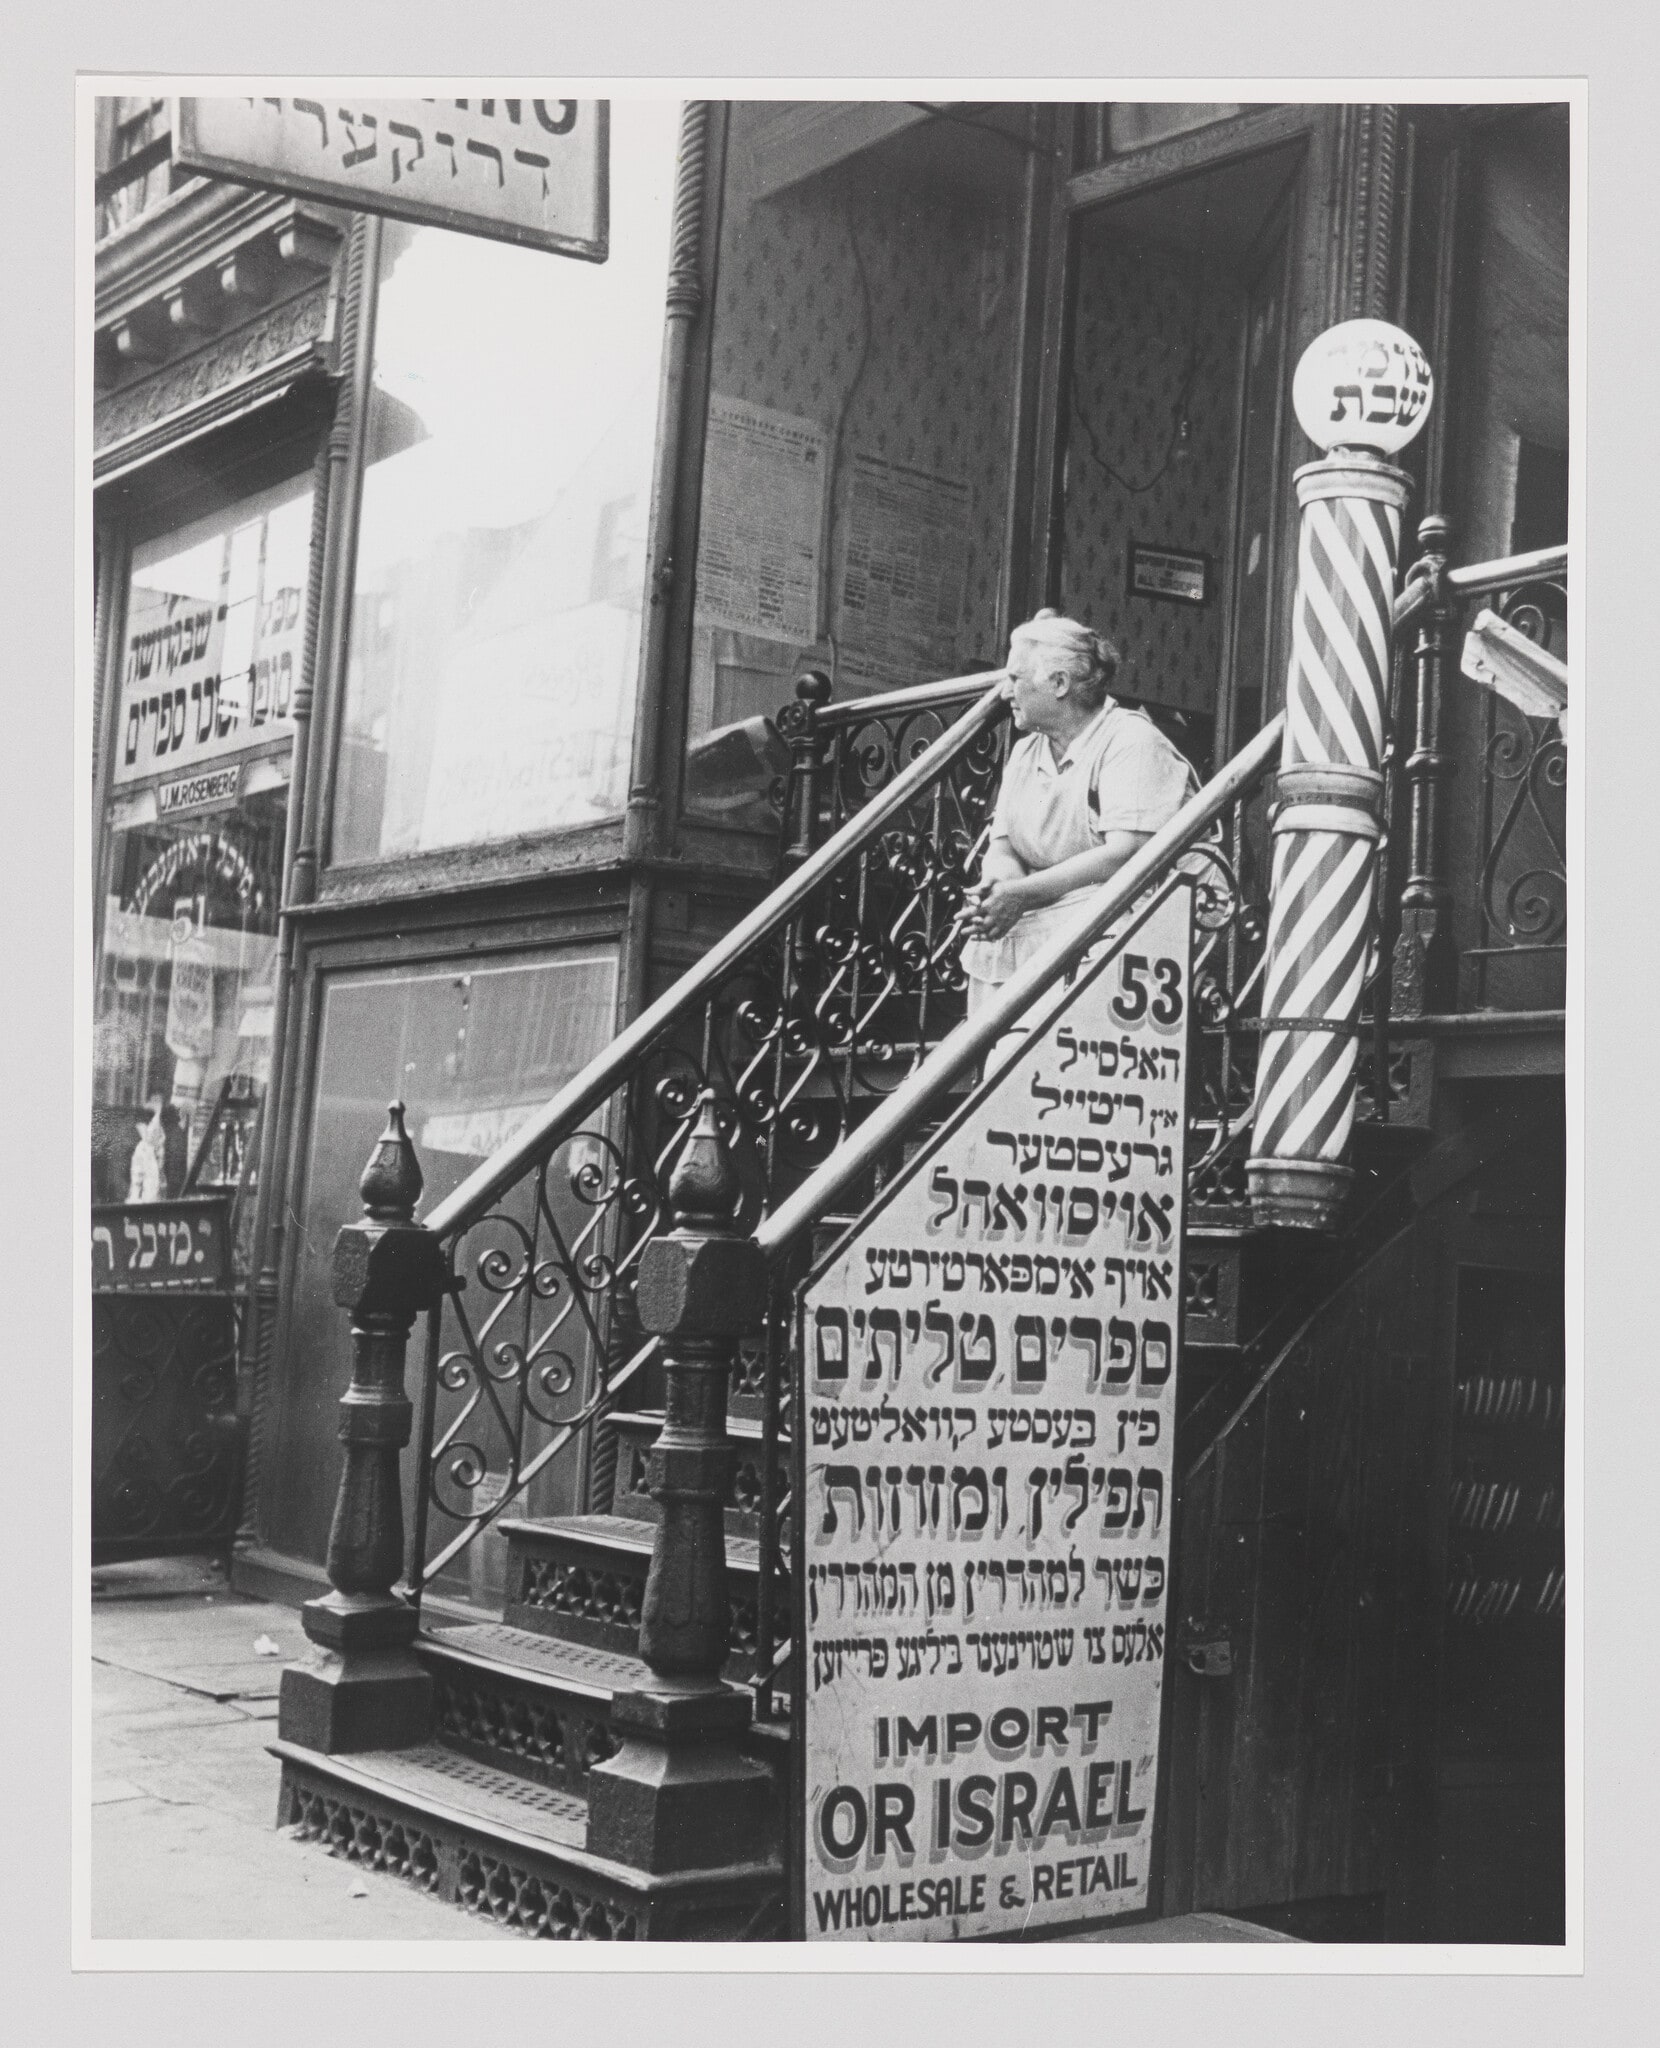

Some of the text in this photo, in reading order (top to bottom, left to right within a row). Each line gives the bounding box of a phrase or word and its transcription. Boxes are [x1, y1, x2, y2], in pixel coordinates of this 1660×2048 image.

[1329, 384, 1427, 427] שבת
[124, 686, 188, 766] ספרים
[1111, 952, 1184, 1025] 53
[1056, 1026, 1181, 1083] האלסייל
[1031, 1068, 1178, 1138] אין ריטייל
[986, 1126, 1173, 1183] גרעסטער
[932, 1163, 1175, 1242] אויסוואהל
[123, 1216, 193, 1269] מיכל
[1104, 1257, 1173, 1308] אויף
[814, 1299, 997, 1383] טליתים
[810, 1391, 976, 1451] קוואליטעט
[1117, 1408, 1161, 1454] פין
[819, 1463, 1009, 1534] ומזוזות
[808, 1561, 919, 1624] המהדרין
[926, 1561, 956, 1617] מן
[964, 1544, 1085, 1616] למהדרין
[1083, 1626, 1106, 1665] צו
[1112, 1617, 1167, 1669] אלעס
[877, 1700, 1113, 1758] IMPORT
[813, 1852, 1138, 1935] WHOLESALE & RETAIL
